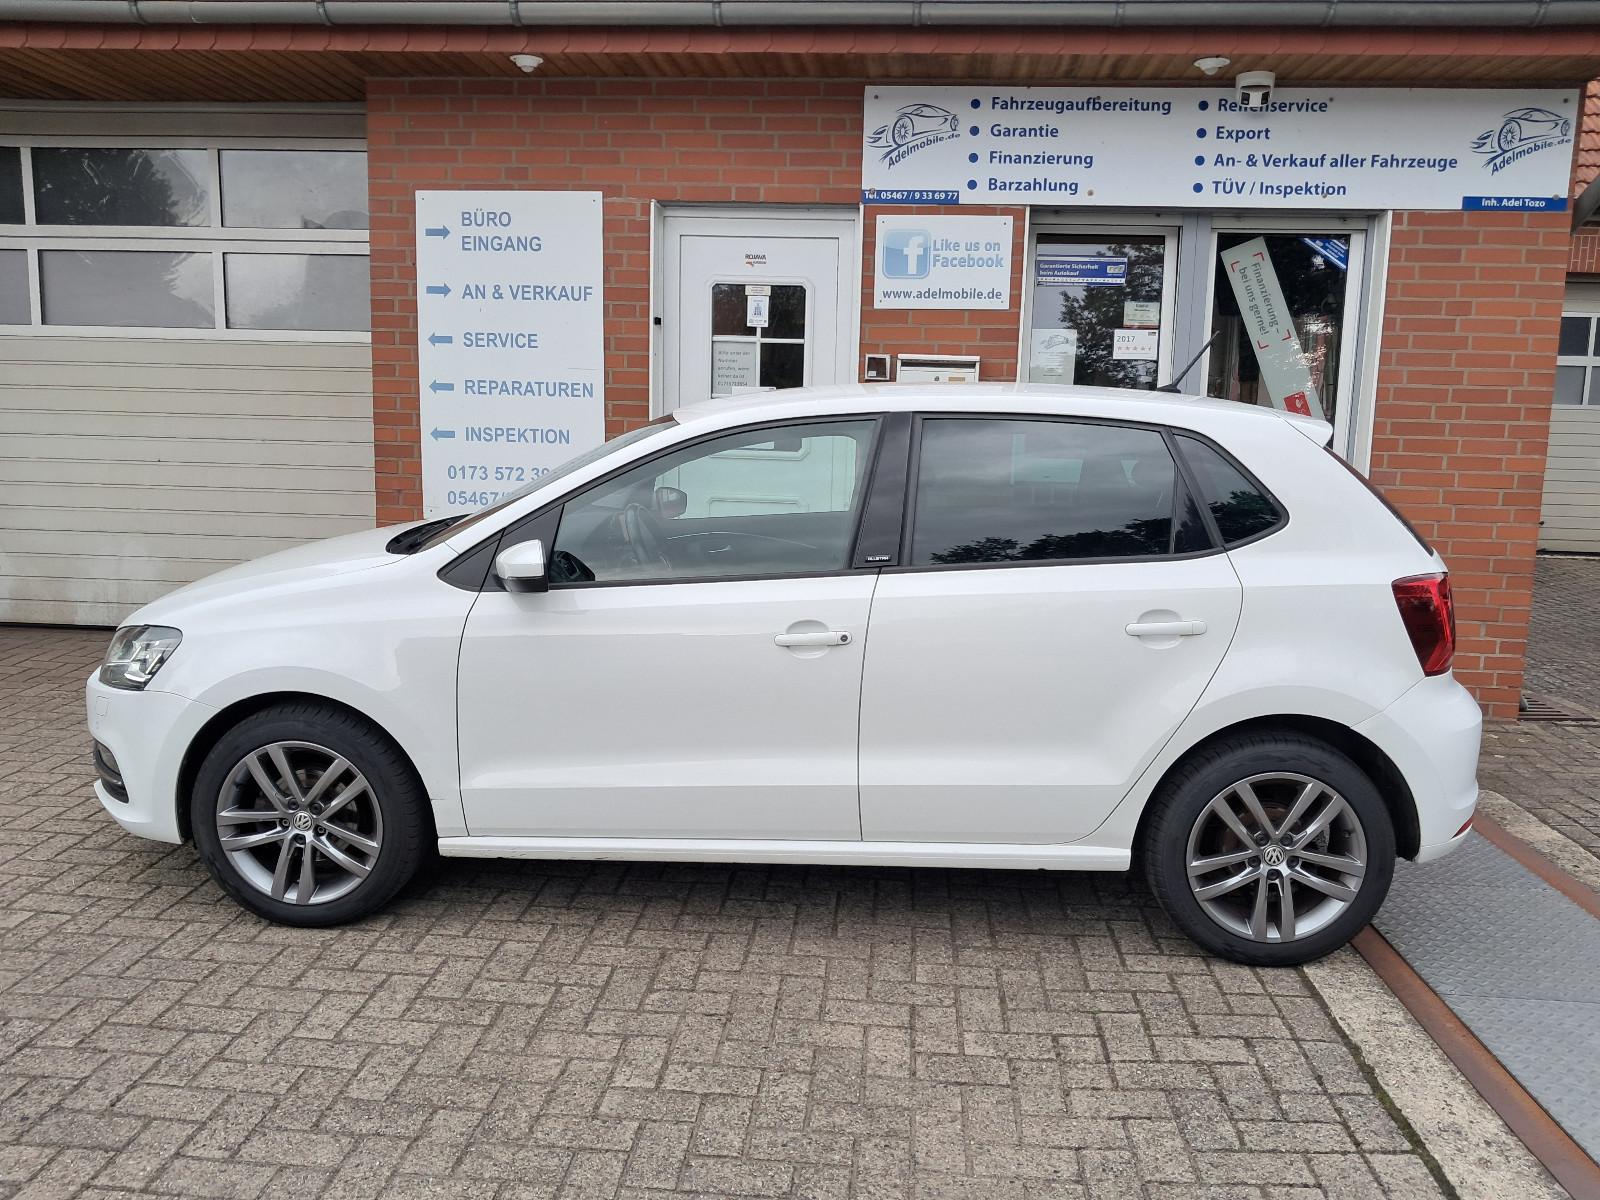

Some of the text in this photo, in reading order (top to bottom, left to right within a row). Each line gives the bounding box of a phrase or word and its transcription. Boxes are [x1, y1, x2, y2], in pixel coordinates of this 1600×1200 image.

[991, 97, 1172, 115] Fahrzeugaufbereitung
[989, 124, 1059, 138] Garantie
[1215, 126, 1271, 143] Export
[888, 133, 960, 170] Adelmobile.de
[988, 150, 1094, 169] Finanzierung
[1491, 138, 1572, 176] Adelmobile.de
[1213, 154, 1458, 172] An- & Verkauf aller Fahrzeuge
[881, 191, 907, 200] 05467
[914, 191, 920, 200] 9
[922, 191, 932, 200] 33
[934, 191, 945, 200] 69
[947, 191, 958, 200] 77
[987, 177, 1079, 196] Barzahlung
[1212, 179, 1347, 199] TÜV / Inspektion
[1481, 198, 1546, 207] Inh. Adel Tozo
[461, 208, 512, 228] BÜRO
[461, 236, 542, 252] EINGANG
[933, 239, 1001, 252] Like us on
[932, 254, 1004, 268] Facebook
[461, 284, 593, 302] AN & VERKAUF
[882, 288, 1002, 300] www.adelmobile.de
[1239, 268, 1269, 336] bei uns gerne!
[1251, 262, 1279, 328] Finanzierung
[463, 332, 539, 349] SERVICE
[464, 380, 594, 398] REPARATUREN
[465, 427, 570, 444] INSPEKTION
[447, 465, 488, 480] 0173
[494, 467, 525, 481] 572
